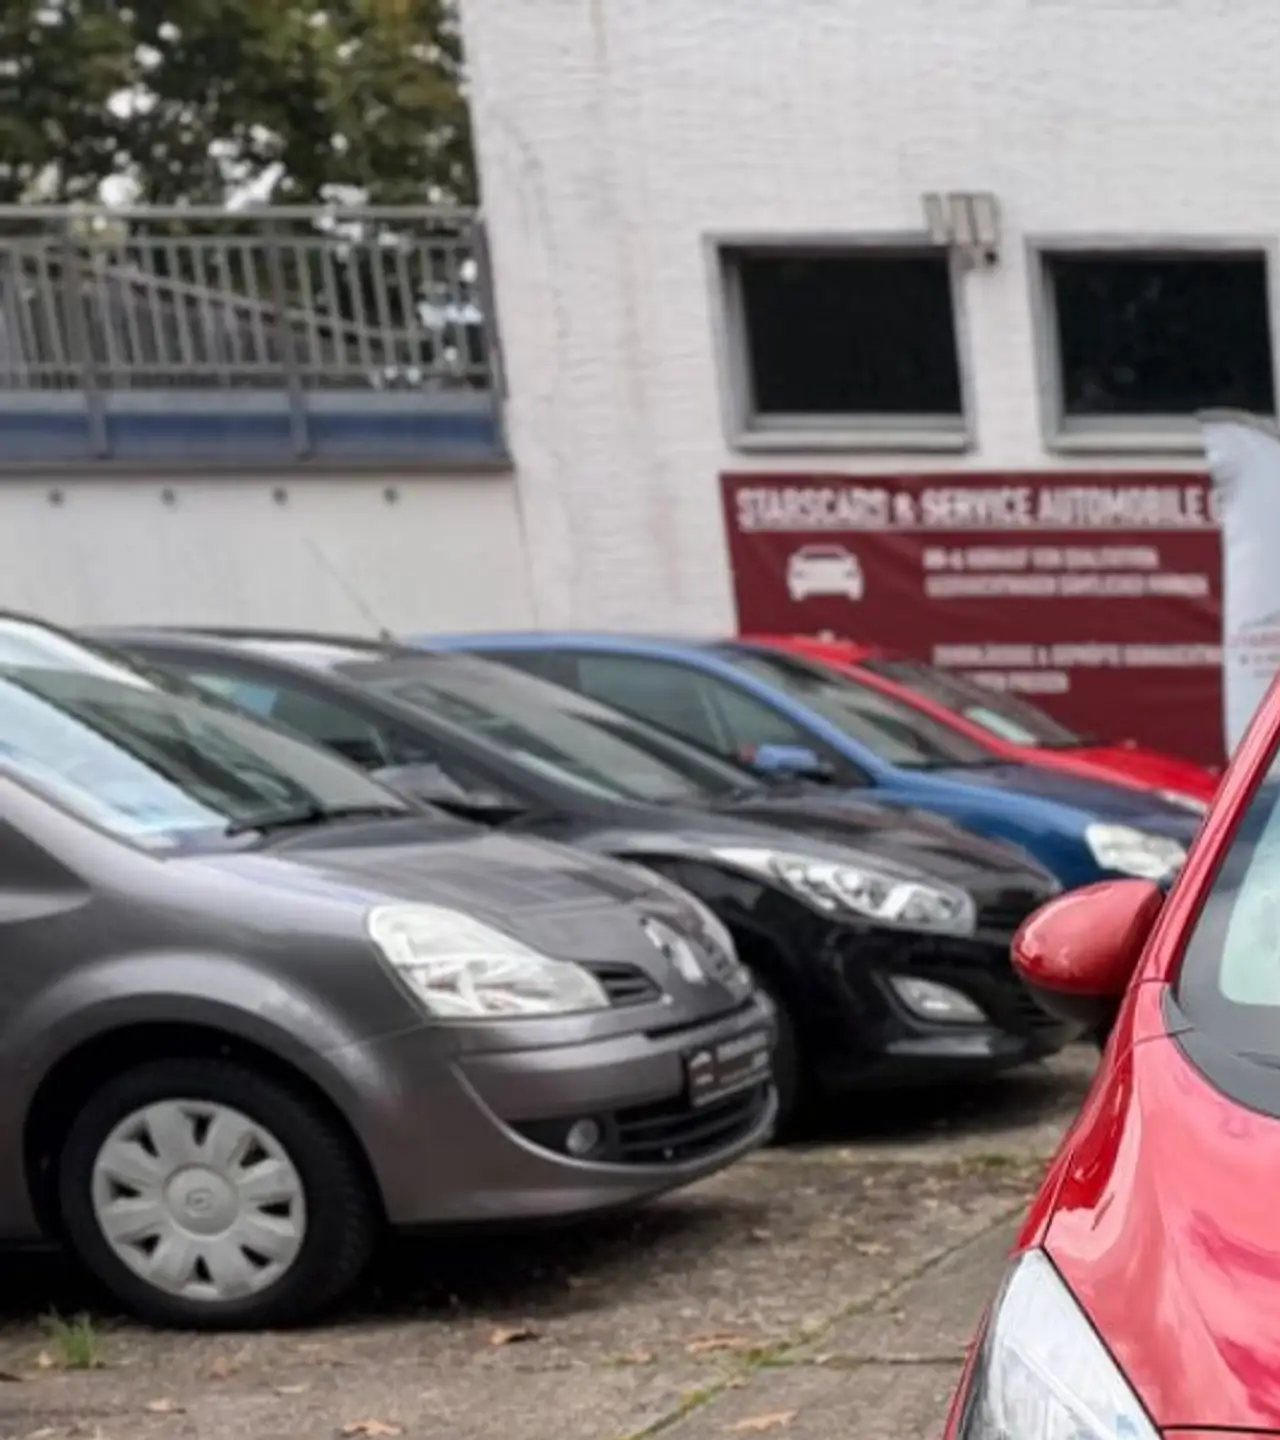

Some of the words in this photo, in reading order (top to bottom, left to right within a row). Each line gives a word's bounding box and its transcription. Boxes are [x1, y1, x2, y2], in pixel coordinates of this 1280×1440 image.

[736, 487, 890, 530] STARSCARS
[921, 487, 1031, 528] SERVICE
[1037, 486, 1205, 528] AUTOMOBILE
